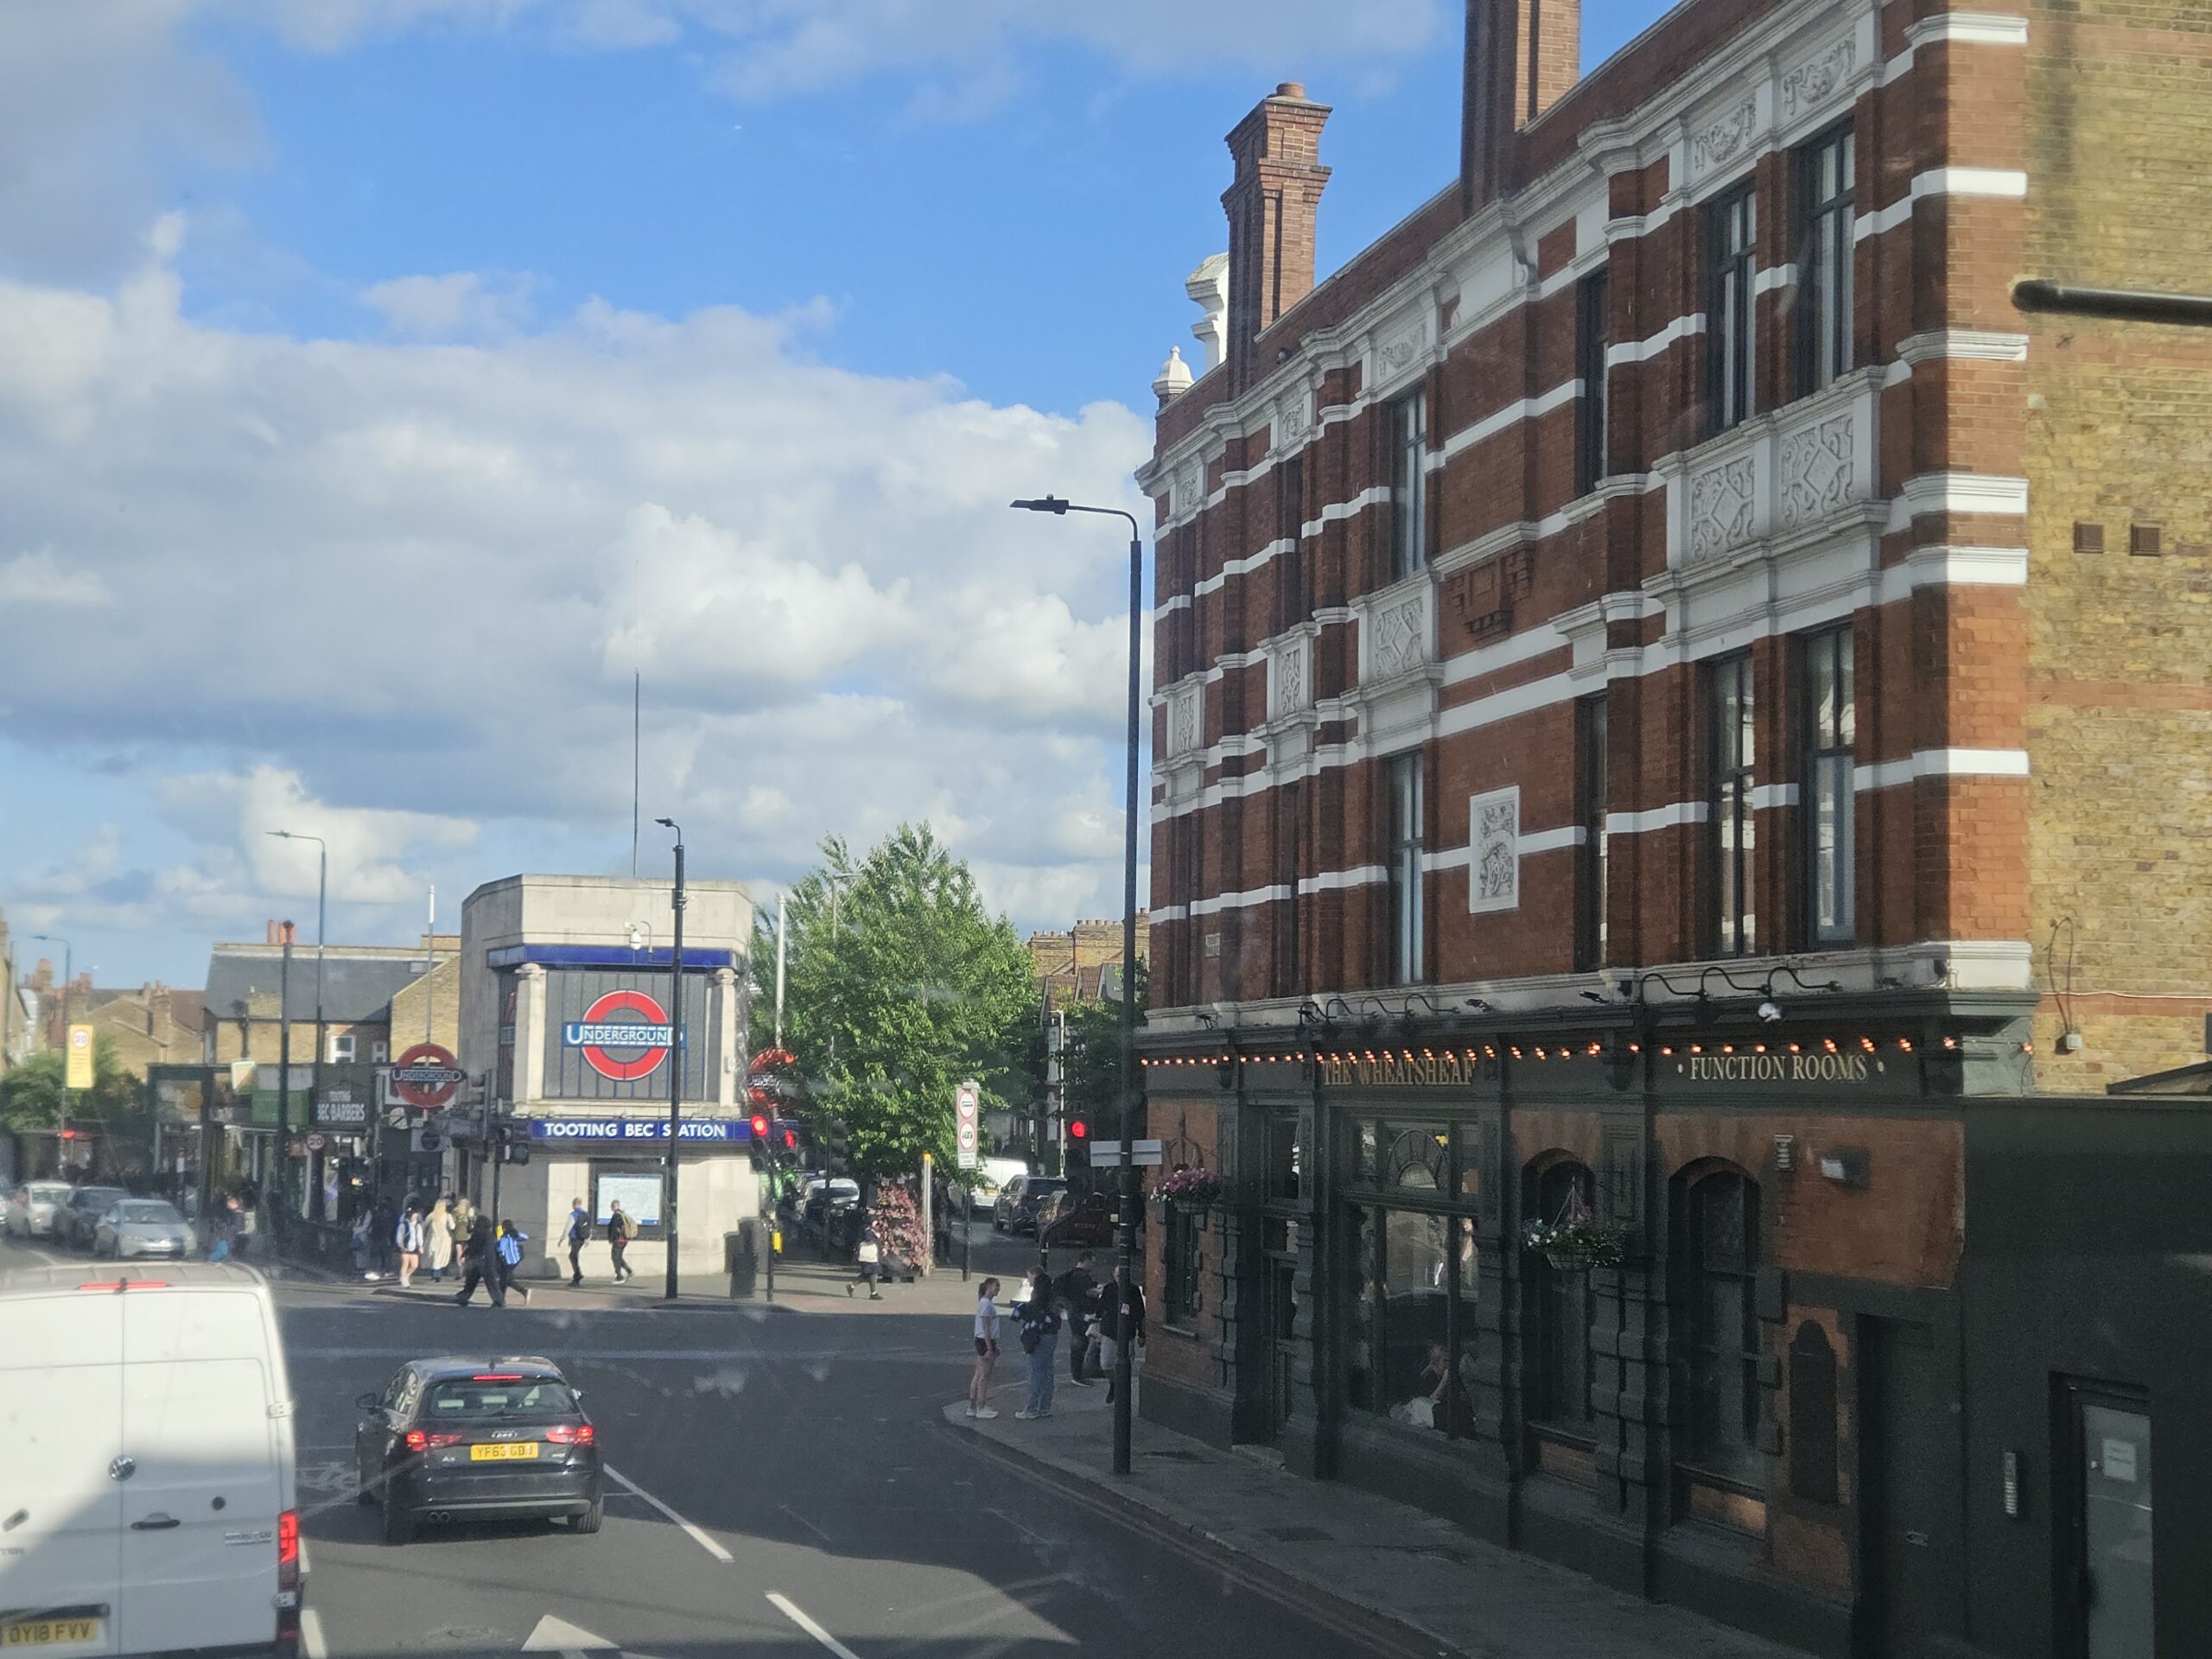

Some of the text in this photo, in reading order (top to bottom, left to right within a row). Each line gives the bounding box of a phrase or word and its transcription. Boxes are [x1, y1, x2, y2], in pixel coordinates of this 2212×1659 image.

[392, 1069, 462, 1082] UNDERGROUND
[1322, 1057, 1475, 1086] THE WHEATSHEAF
[1690, 1054, 1867, 1080] FUNCTION ROOMS
[331, 1103, 365, 1122] BARBERS
[543, 1122, 726, 1138] TOOTING BEC SATION
[308, 1137, 322, 1146] 20
[54, 1621, 91, 1641] FVV
